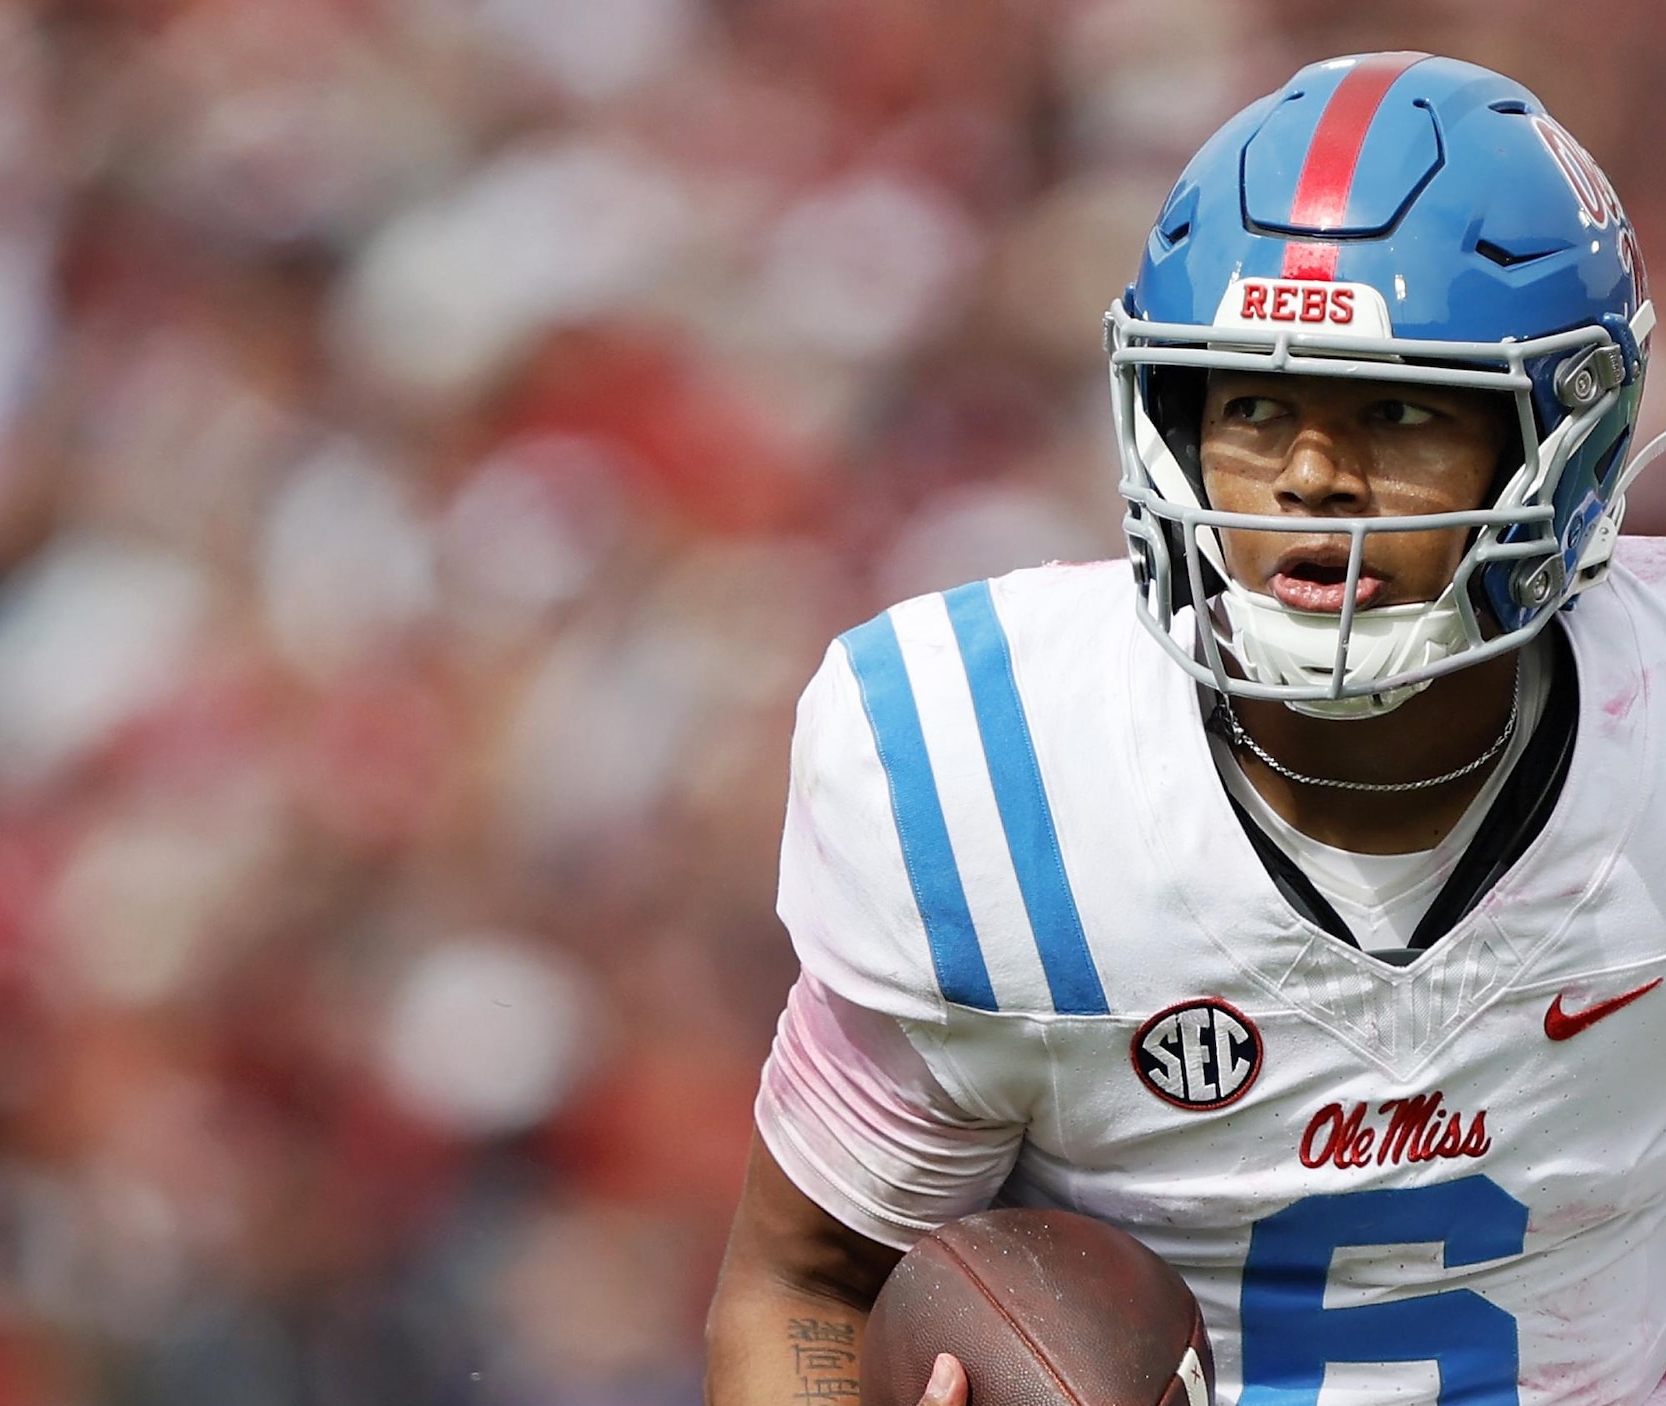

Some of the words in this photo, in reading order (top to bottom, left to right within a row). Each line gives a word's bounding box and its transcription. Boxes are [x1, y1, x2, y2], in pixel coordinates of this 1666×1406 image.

[1240, 282, 1355, 324] REBS
[1141, 1006, 1252, 1103] SEC
[1299, 1101, 1373, 1170] Ole
[1376, 1090, 1492, 1169] Miss
